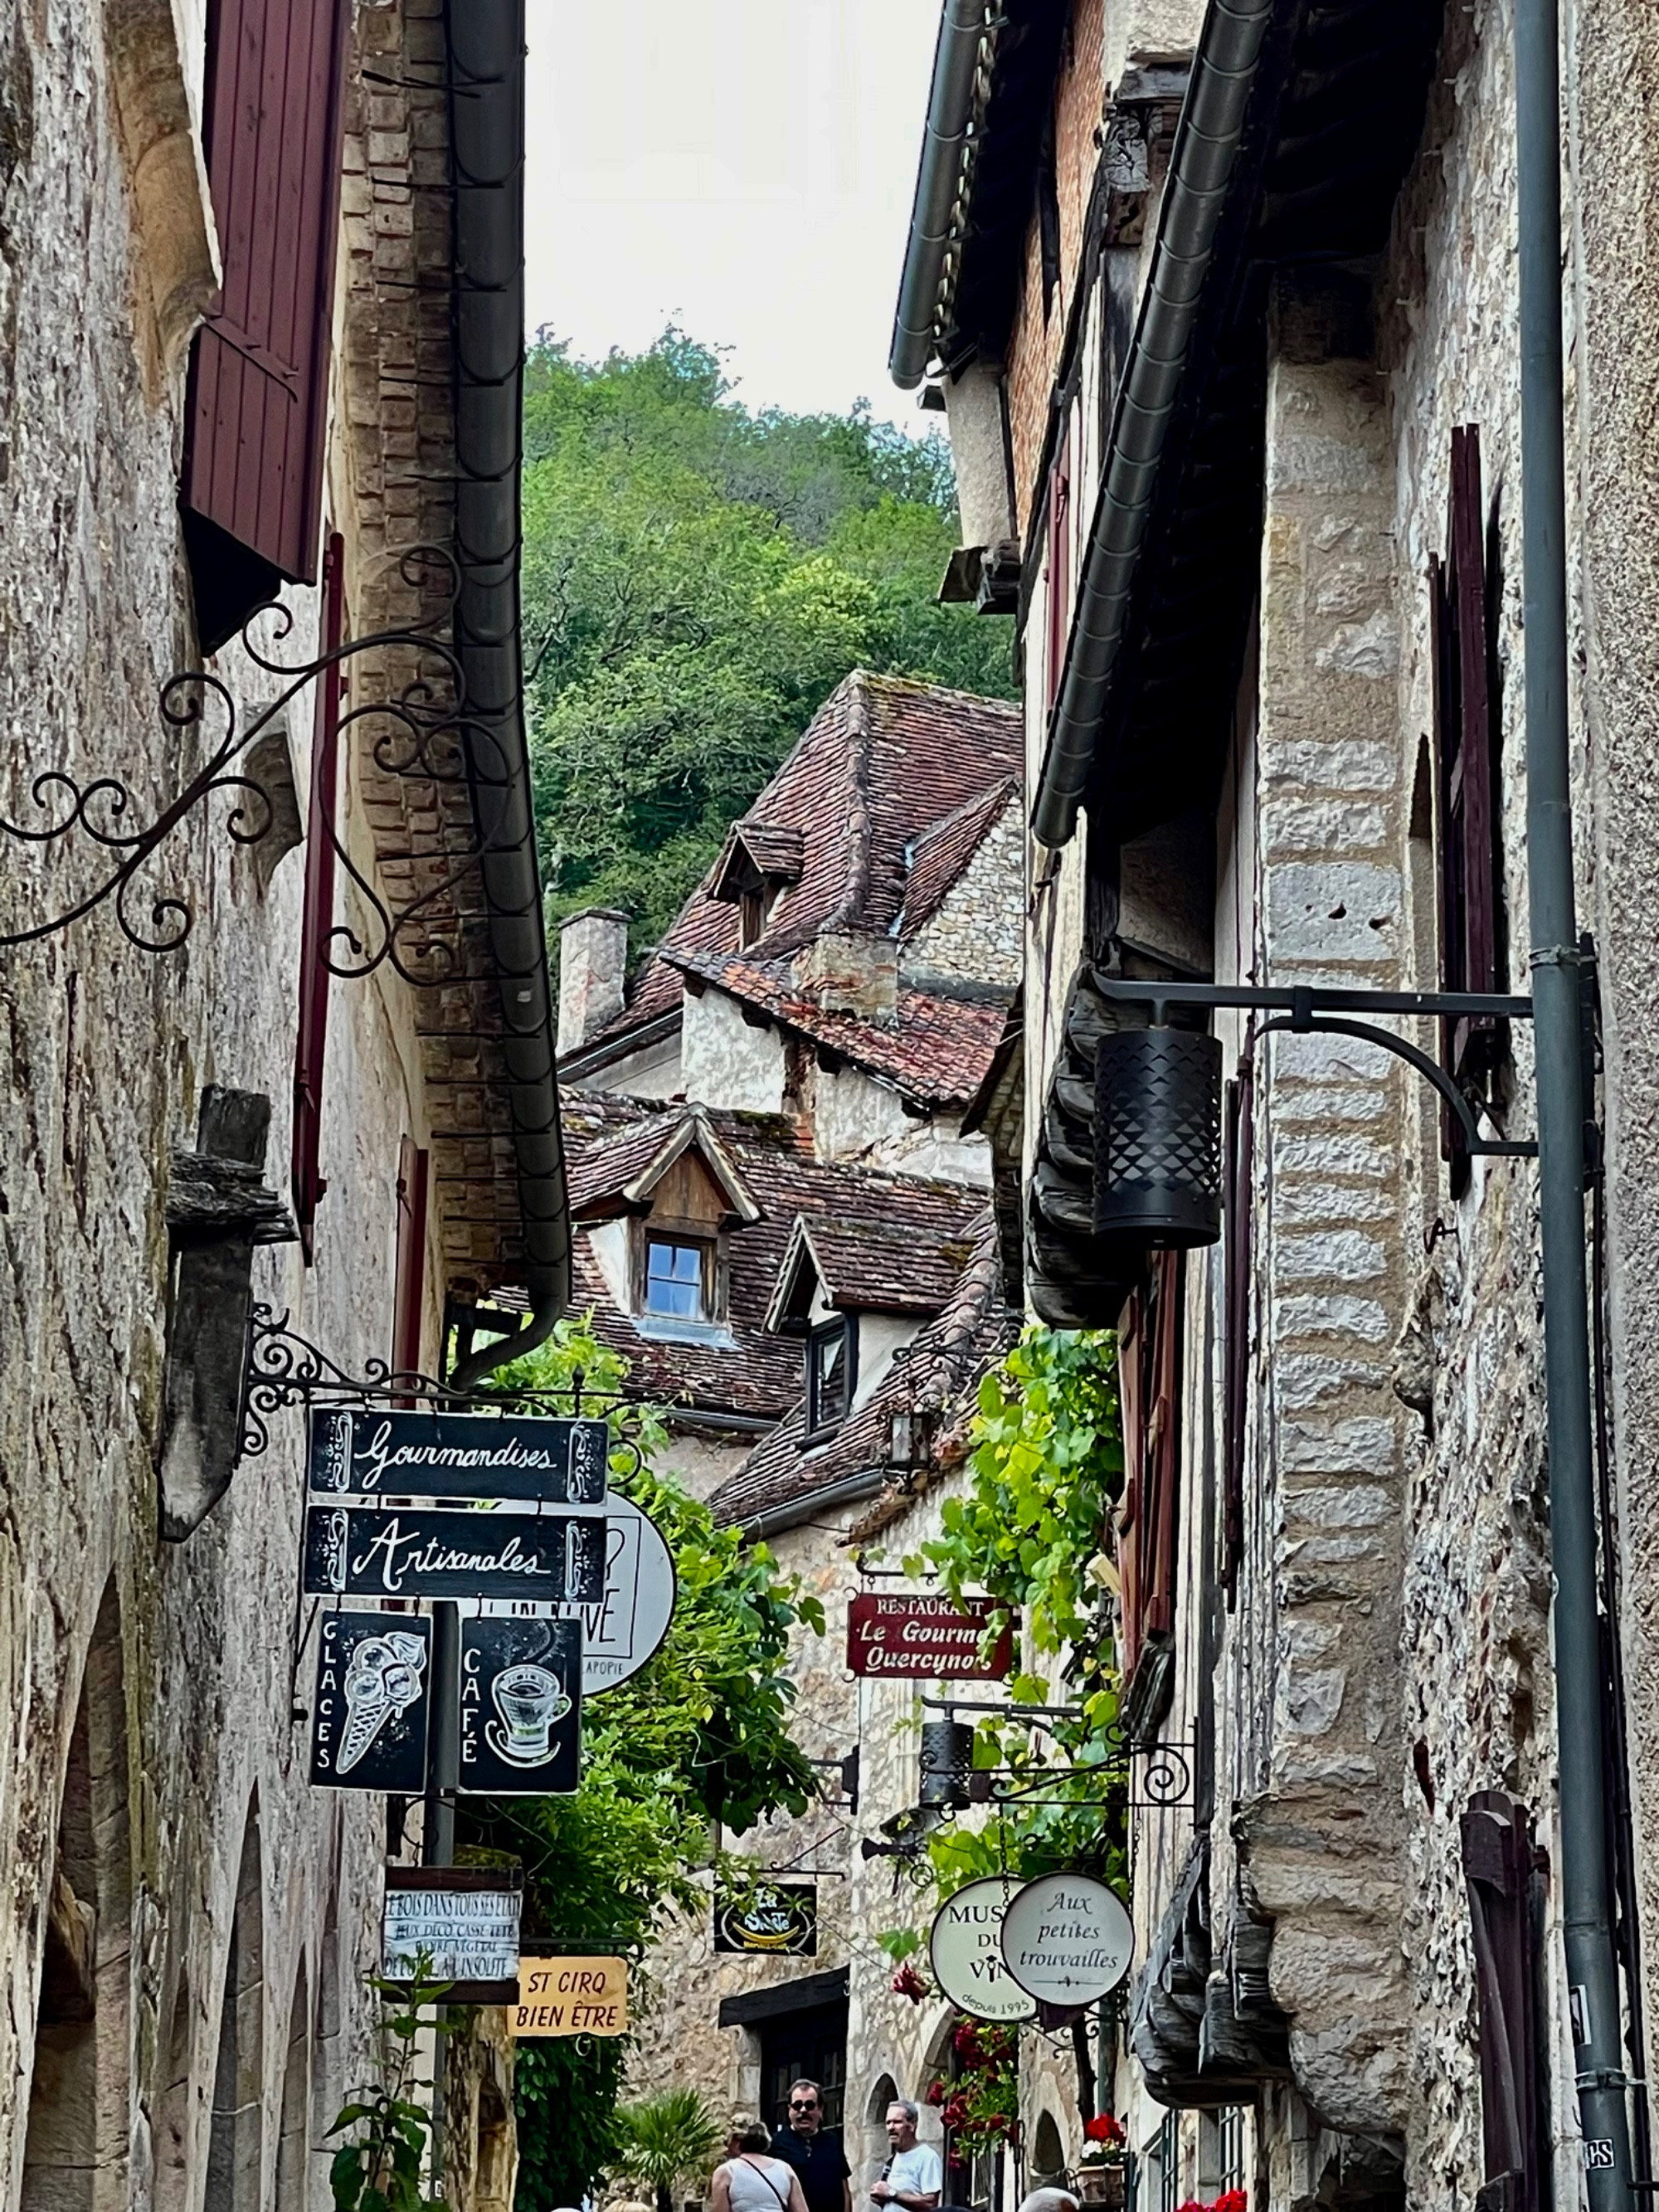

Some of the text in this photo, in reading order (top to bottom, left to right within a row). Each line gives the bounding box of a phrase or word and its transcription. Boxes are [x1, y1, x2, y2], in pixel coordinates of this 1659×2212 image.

[354, 1420, 557, 1489] Gourmandises
[353, 1518, 552, 1591] Artisanales
[860, 1620, 887, 1641] Le
[582, 1661, 624, 1676] APOPIE
[317, 1621, 338, 1768] GLACES
[462, 1648, 481, 1762] CAFÉ
[1047, 1893, 1093, 1915] Aux
[1037, 1920, 1100, 1943] petites
[1019, 1949, 1118, 1969] trouvailles
[528, 1971, 606, 1994] ST CIRQ
[516, 2000, 618, 2028] BIEN ÊTRE
[1000, 2000, 1030, 2015] 1995
